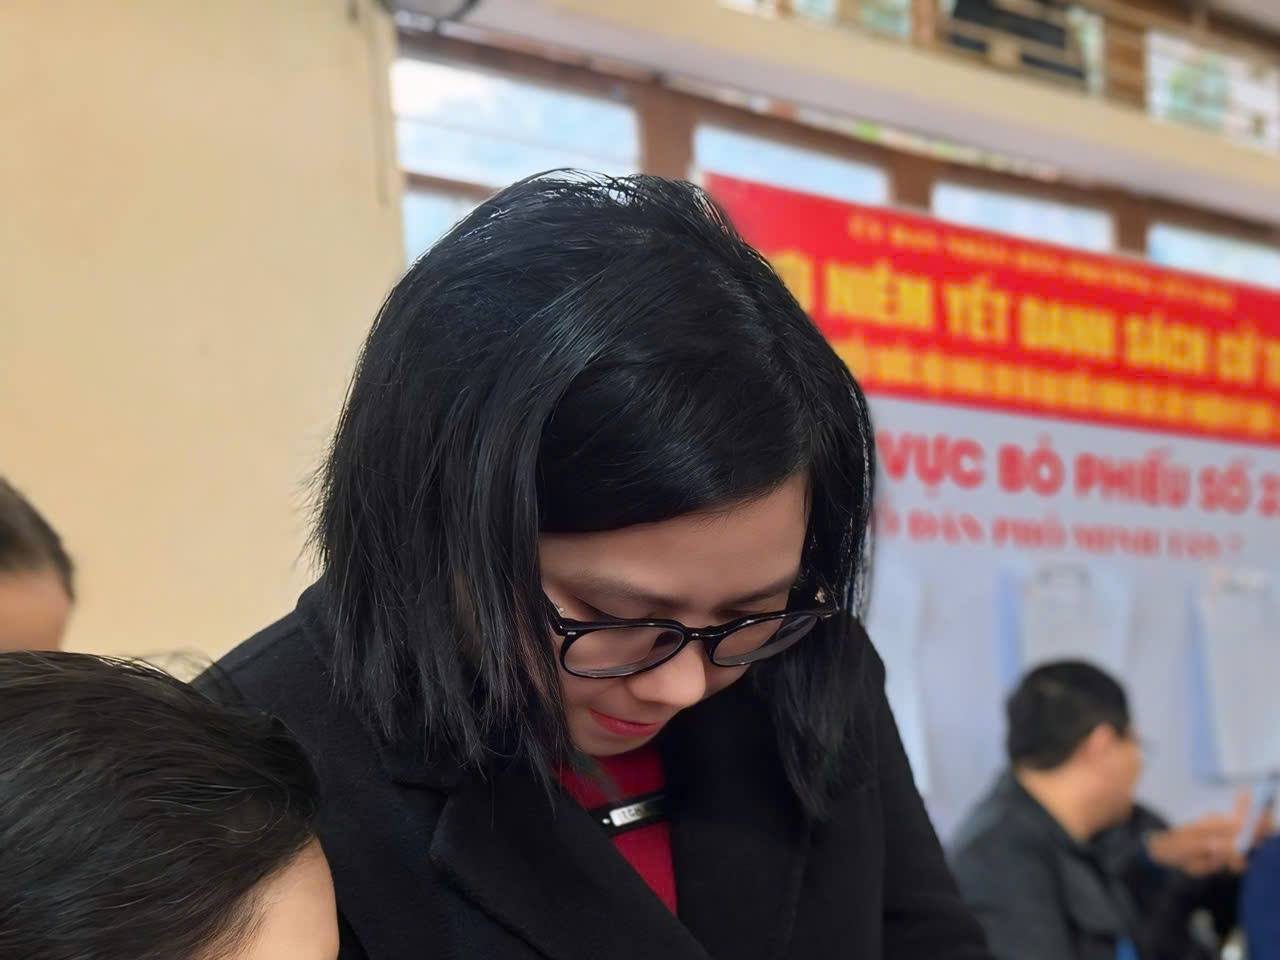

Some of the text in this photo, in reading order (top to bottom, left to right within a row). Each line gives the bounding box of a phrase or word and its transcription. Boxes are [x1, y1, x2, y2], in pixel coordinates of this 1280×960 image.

[943, 273, 1007, 341] YẾT
[1019, 297, 1116, 358] DANH
[1124, 305, 1209, 375] SÁCH
[876, 431, 985, 496] VỰC
[996, 433, 1064, 497] BỎ
[1073, 445, 1192, 511] PHIẾU
[1199, 457, 1253, 515] SỐ
